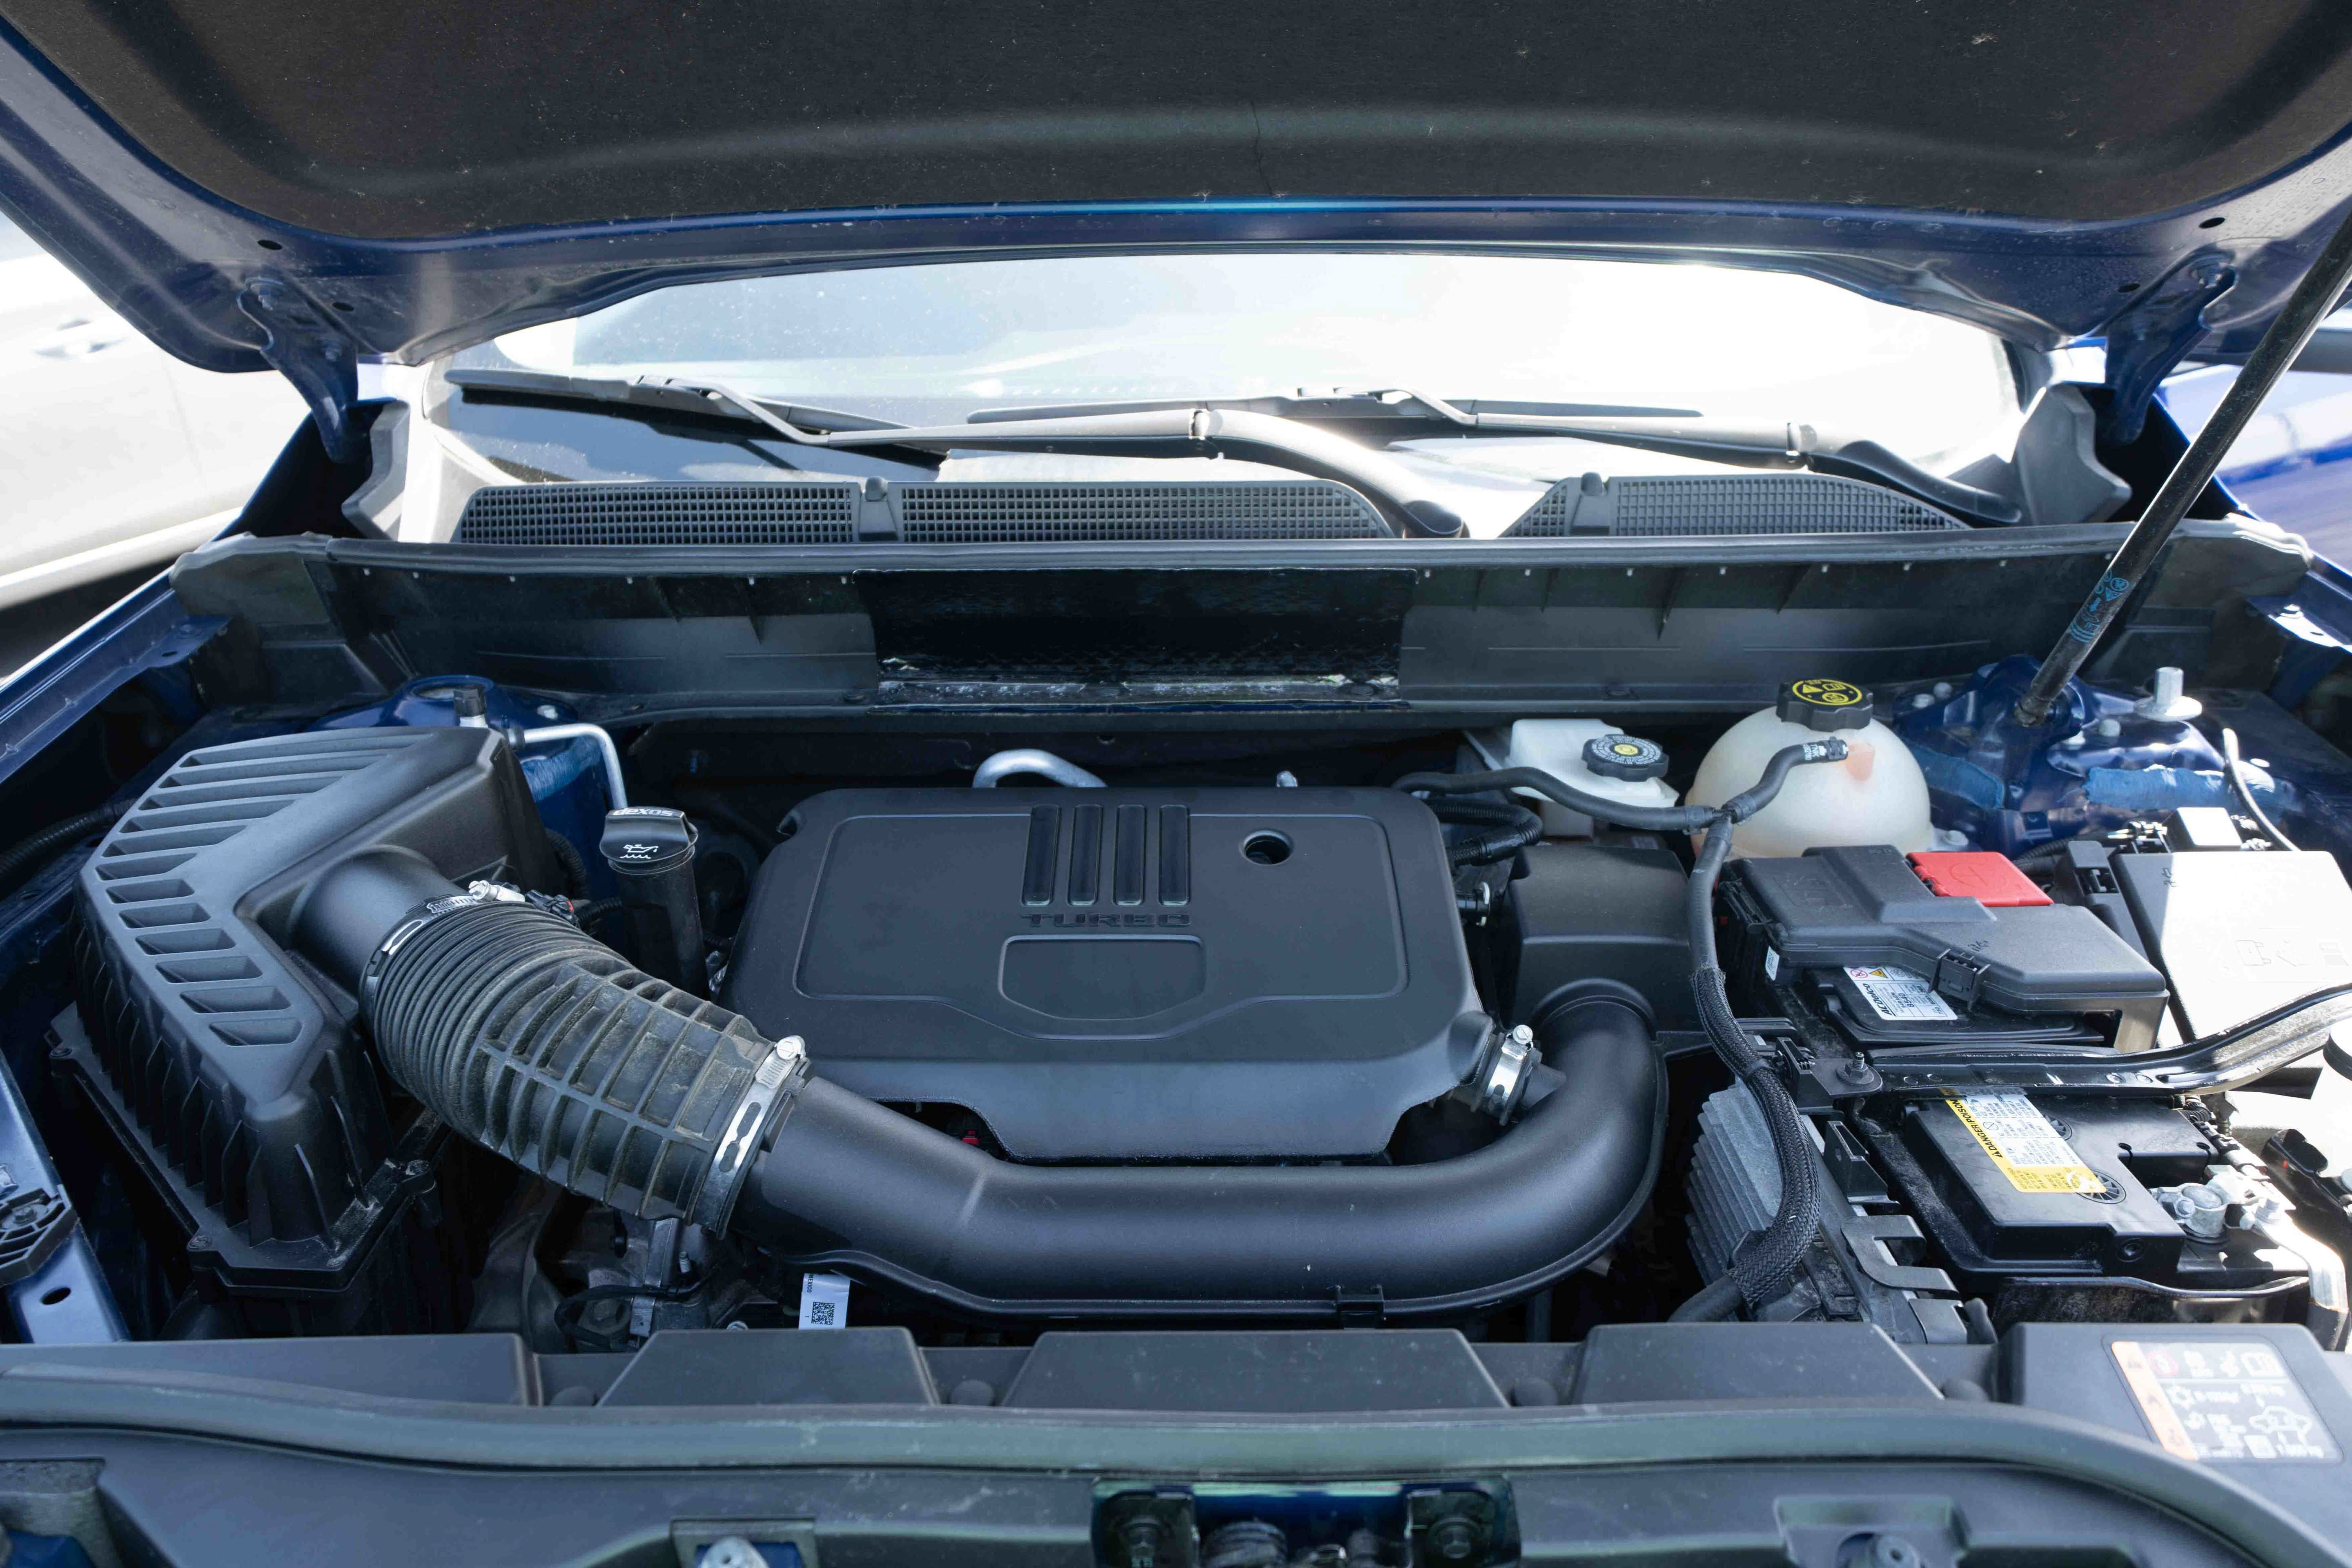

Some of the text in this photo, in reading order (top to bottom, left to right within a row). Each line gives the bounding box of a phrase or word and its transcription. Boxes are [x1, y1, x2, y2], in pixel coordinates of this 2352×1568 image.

[1810, 744, 1820, 757] TNK
[612, 808, 675, 816] dexos
[1022, 913, 1192, 927] TURBO
[1863, 983, 1892, 1016] ACDelco
[1898, 993, 1915, 1007] 8540
